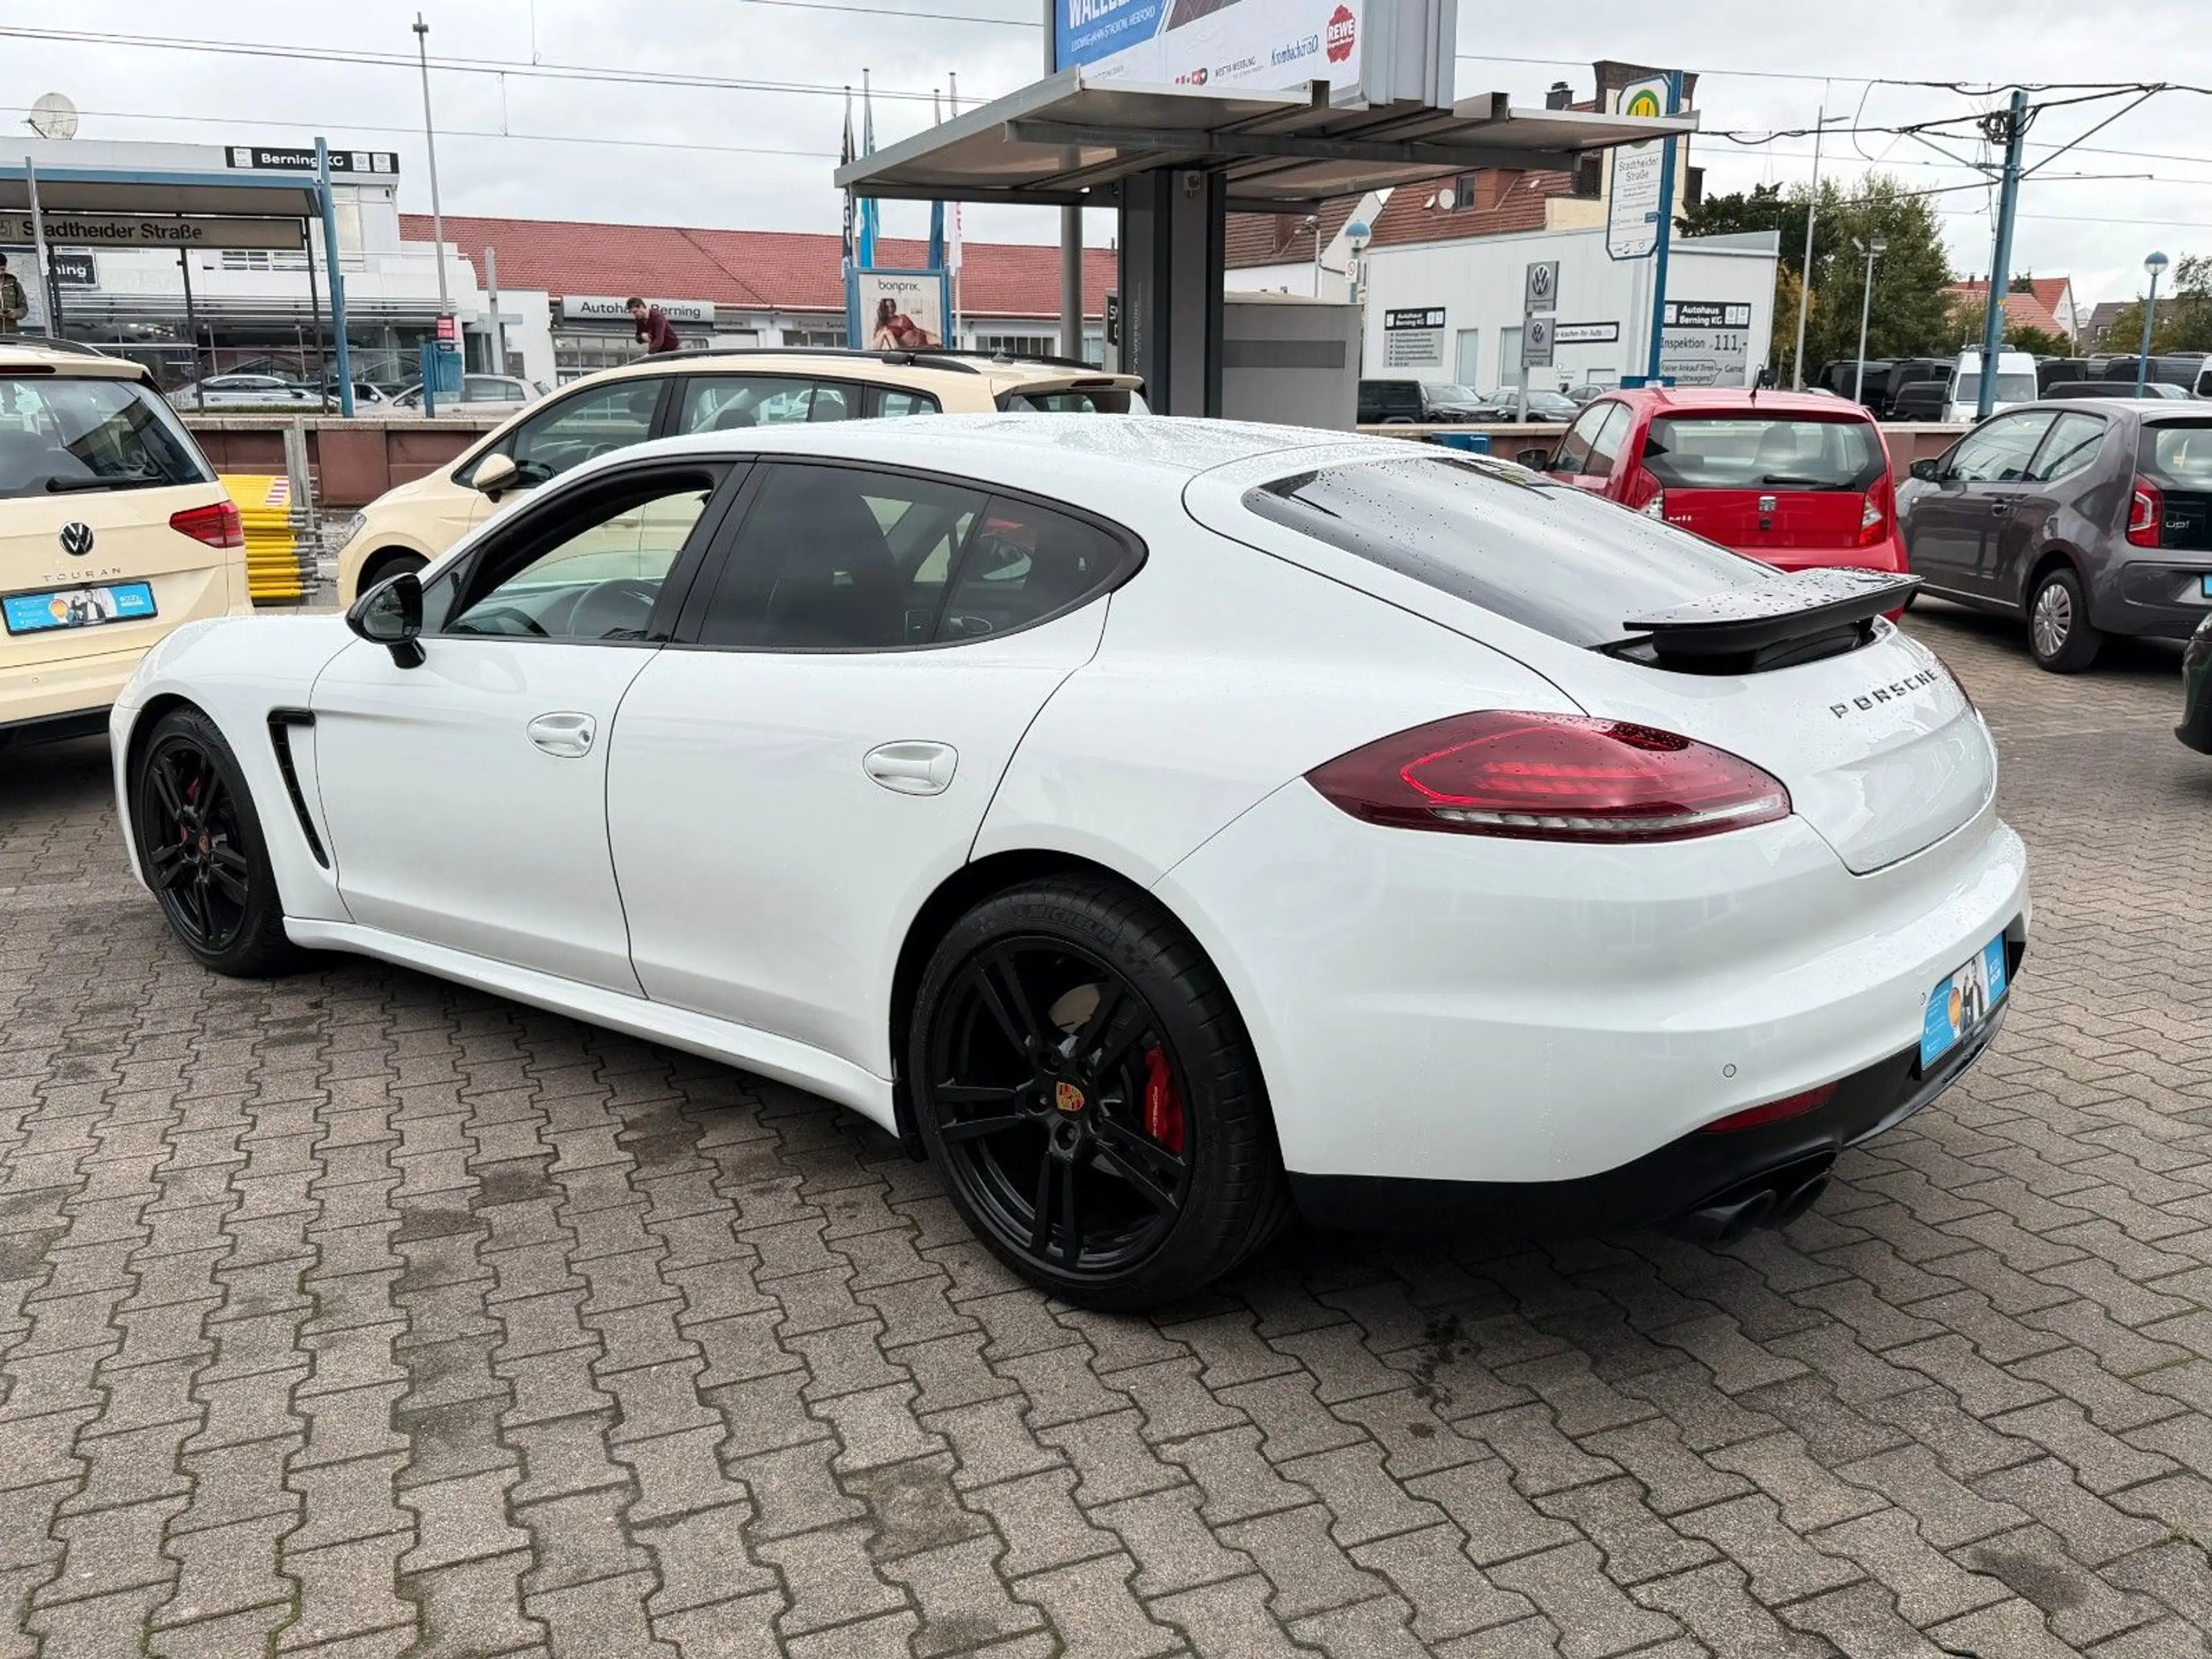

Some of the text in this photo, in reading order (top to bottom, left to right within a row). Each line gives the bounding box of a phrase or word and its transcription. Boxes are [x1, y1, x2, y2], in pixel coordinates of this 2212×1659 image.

[1328, 18, 1354, 41] REWE
[261, 153, 317, 168] Berning
[1619, 156, 1659, 172] Stadtheider
[22, 220, 203, 240] Sadtheider Straße
[878, 278, 918, 294] bonprix
[1681, 305, 1719, 315] Autohaus
[1679, 316, 1723, 327] Berning KG
[1661, 337, 1706, 350] Inspektion
[42, 567, 121, 582] TOURAN
[1829, 669, 1938, 719] PORSCHE
